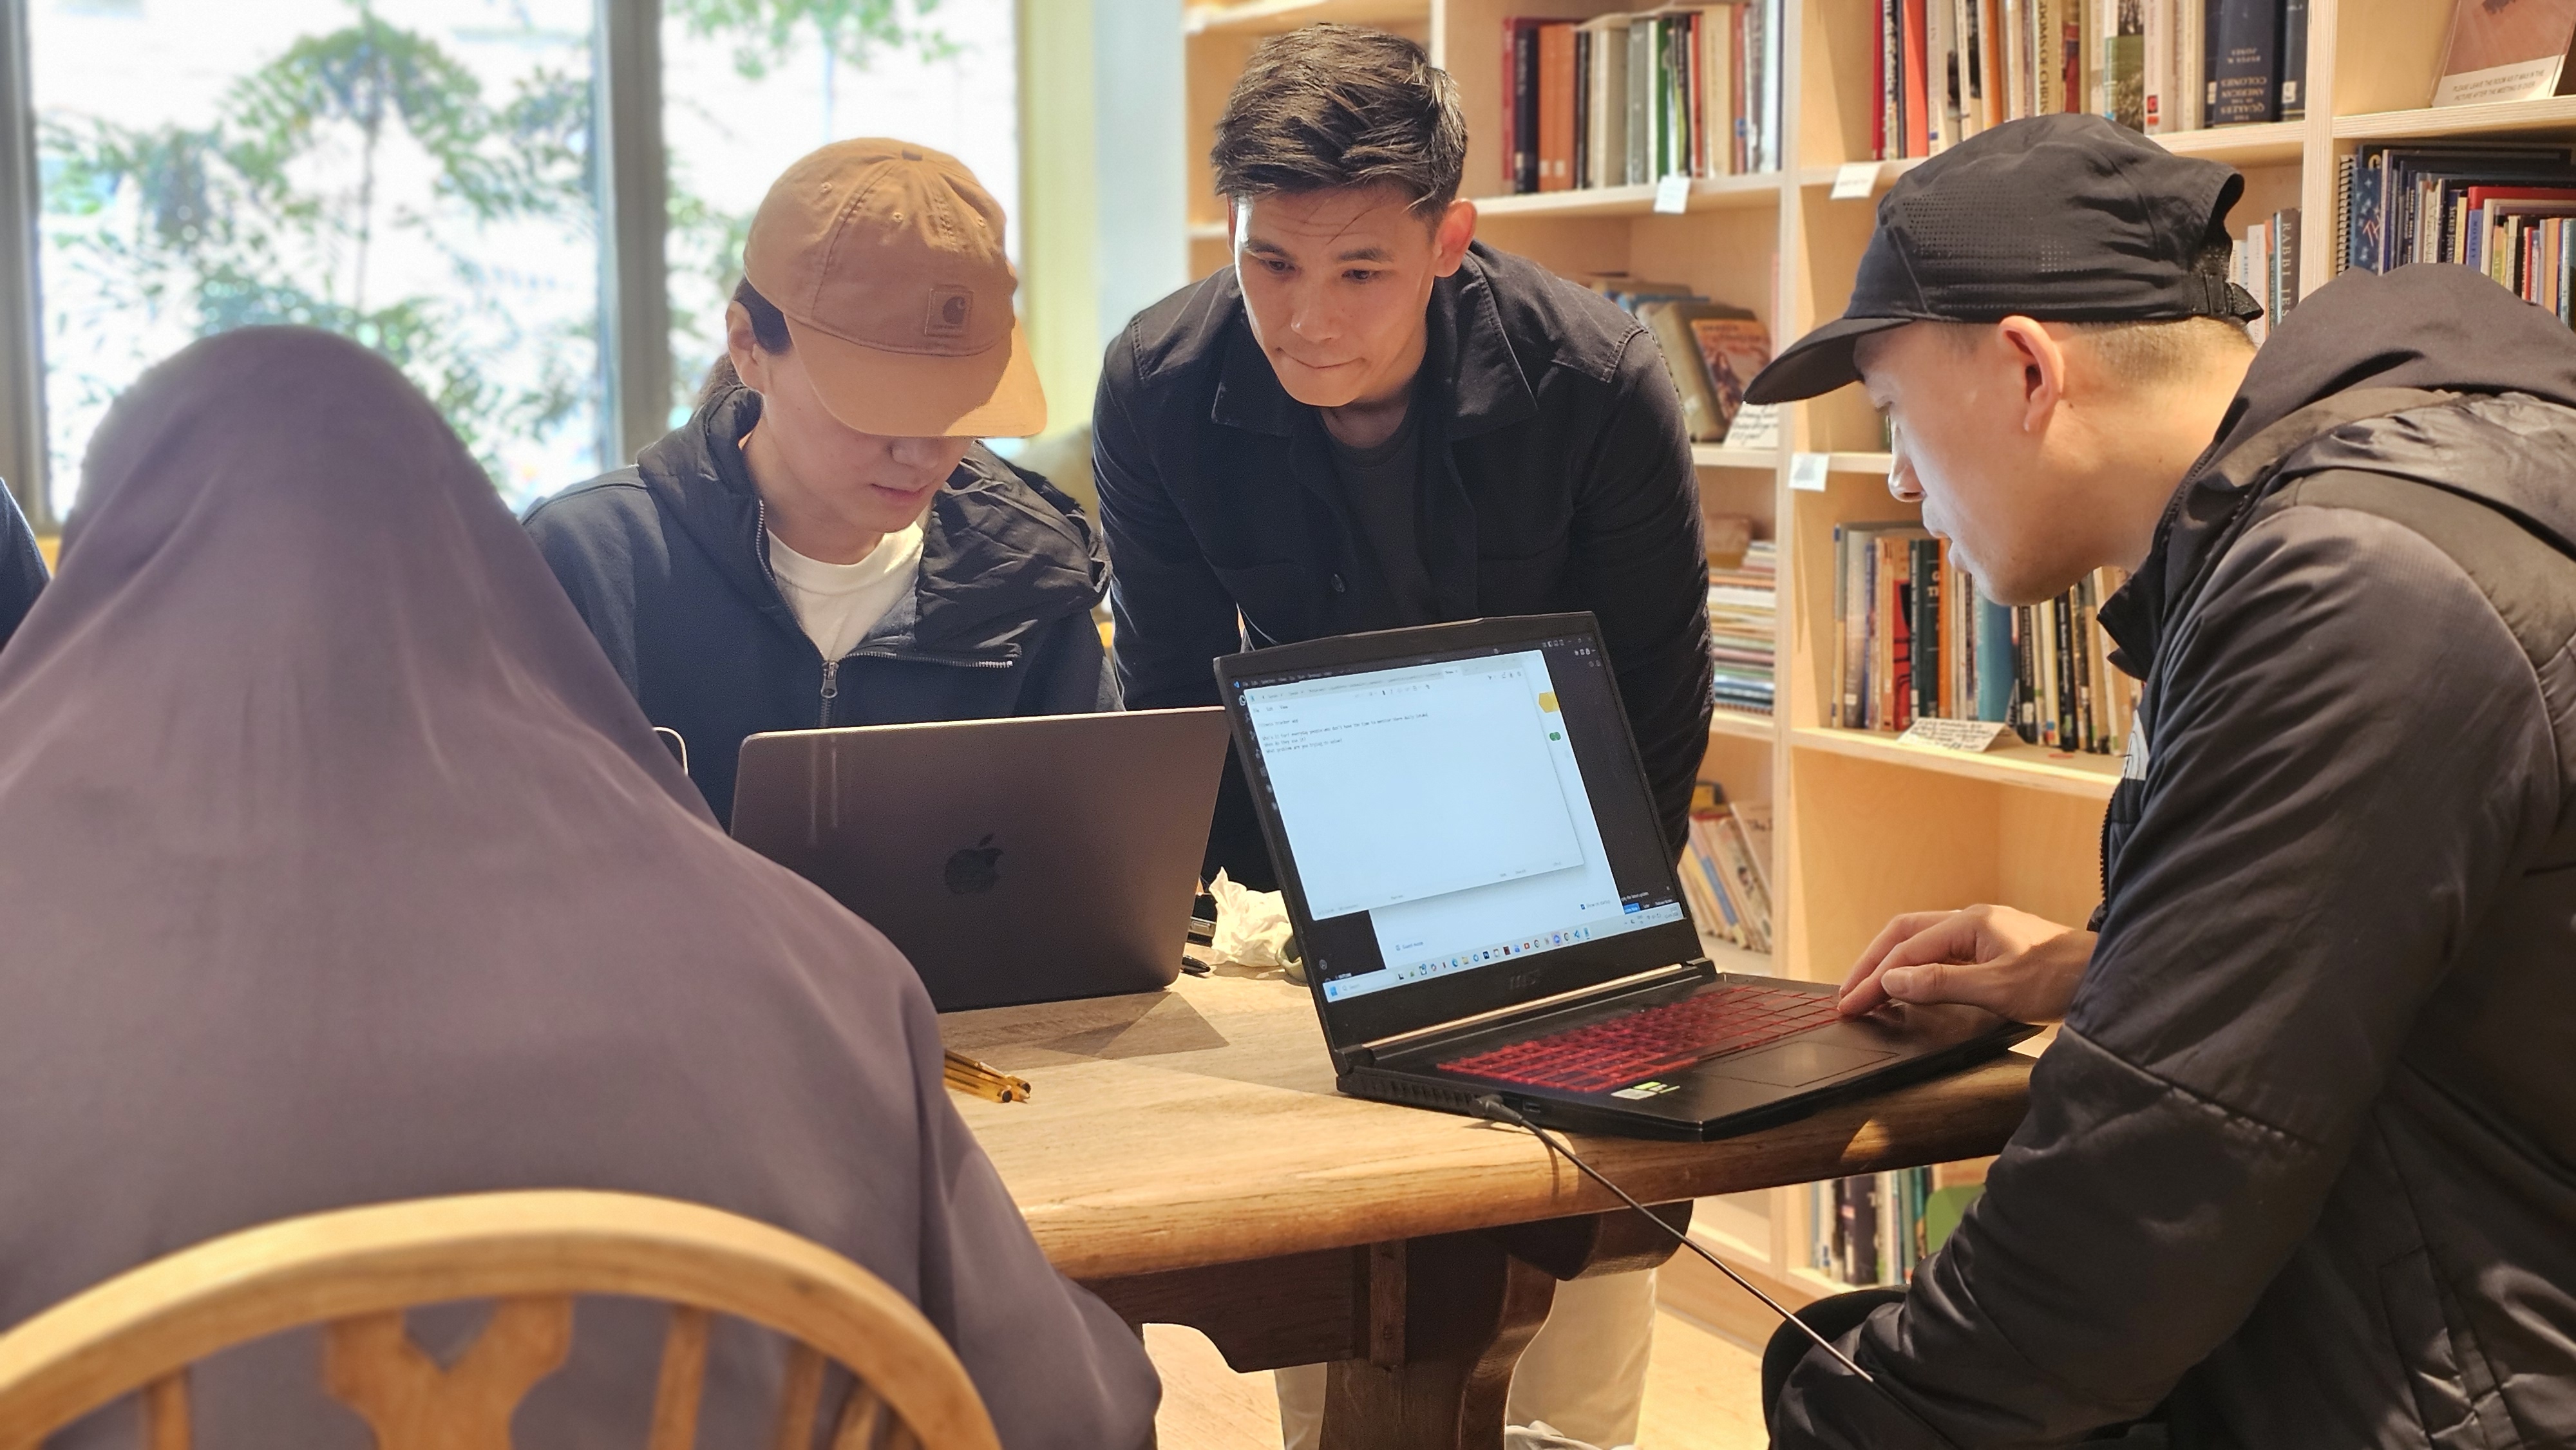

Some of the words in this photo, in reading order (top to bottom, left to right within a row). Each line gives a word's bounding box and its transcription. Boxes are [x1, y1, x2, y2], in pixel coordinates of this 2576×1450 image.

[2040, 50, 2048, 67] OF
[2220, 76, 2268, 87] COLONIES
[2221, 89, 2265, 98] AMERICAN
[2454, 93, 2472, 101] PICTURE
[2473, 89, 2488, 98] AFTER
[2220, 102, 2265, 114] QUAKERS
[2282, 223, 2292, 276] RABBI
[2280, 287, 2291, 317] JES
